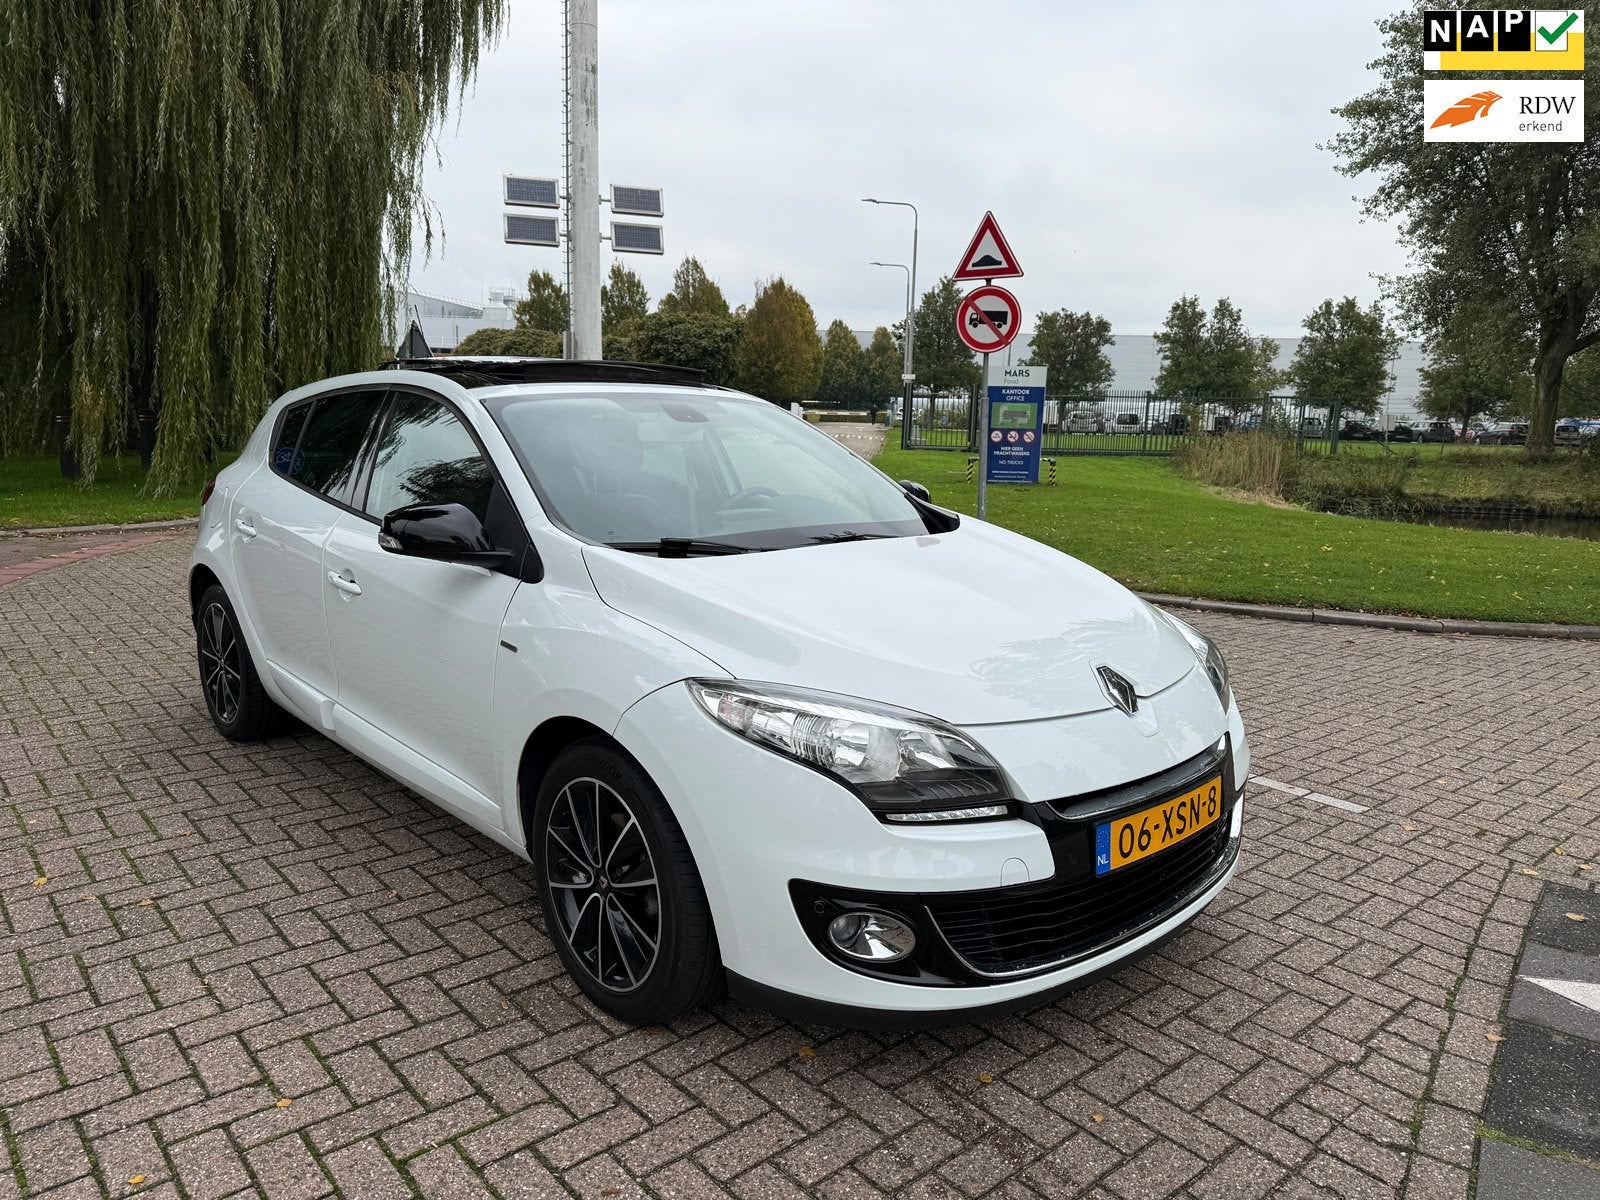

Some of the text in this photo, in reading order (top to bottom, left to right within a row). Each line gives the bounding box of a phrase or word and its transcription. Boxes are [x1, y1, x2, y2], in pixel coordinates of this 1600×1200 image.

[1004, 369, 1030, 377] MARS
[1118, 785, 1217, 859] 06-XSN-8
[1097, 853, 1109, 866] NL
